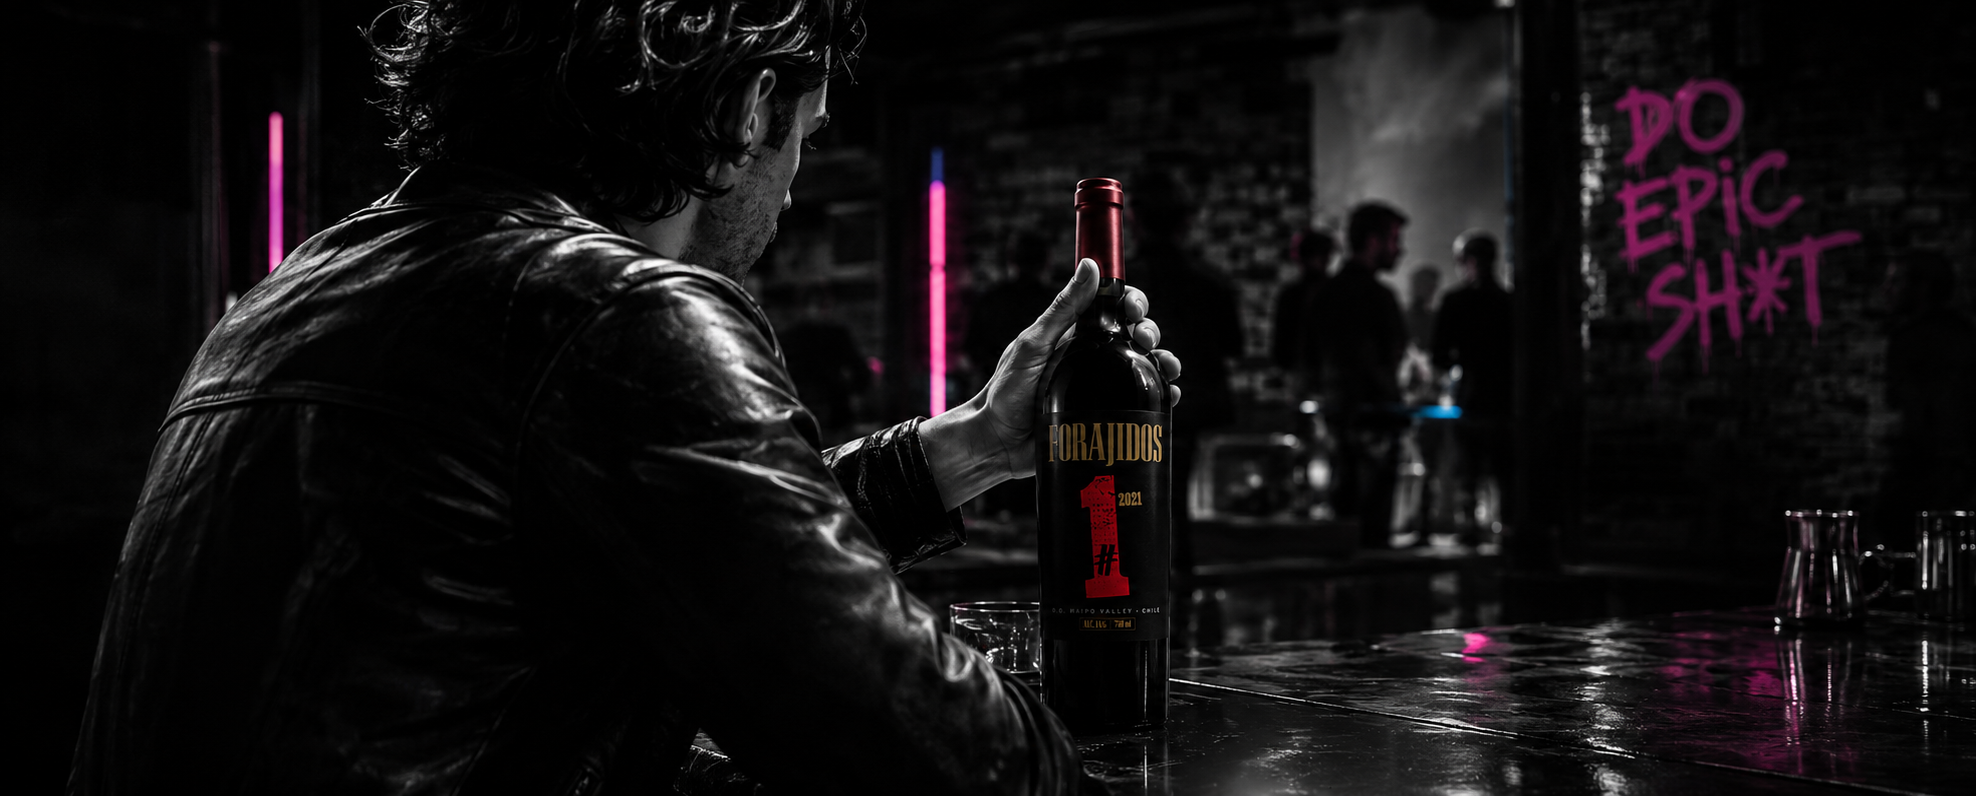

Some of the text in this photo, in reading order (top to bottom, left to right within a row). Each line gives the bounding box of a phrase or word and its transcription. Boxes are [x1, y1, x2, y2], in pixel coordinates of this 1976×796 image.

[1615, 79, 1745, 168] DO
[1048, 422, 1163, 467] FORAJIDOS
[1118, 491, 1143, 507] 2021
